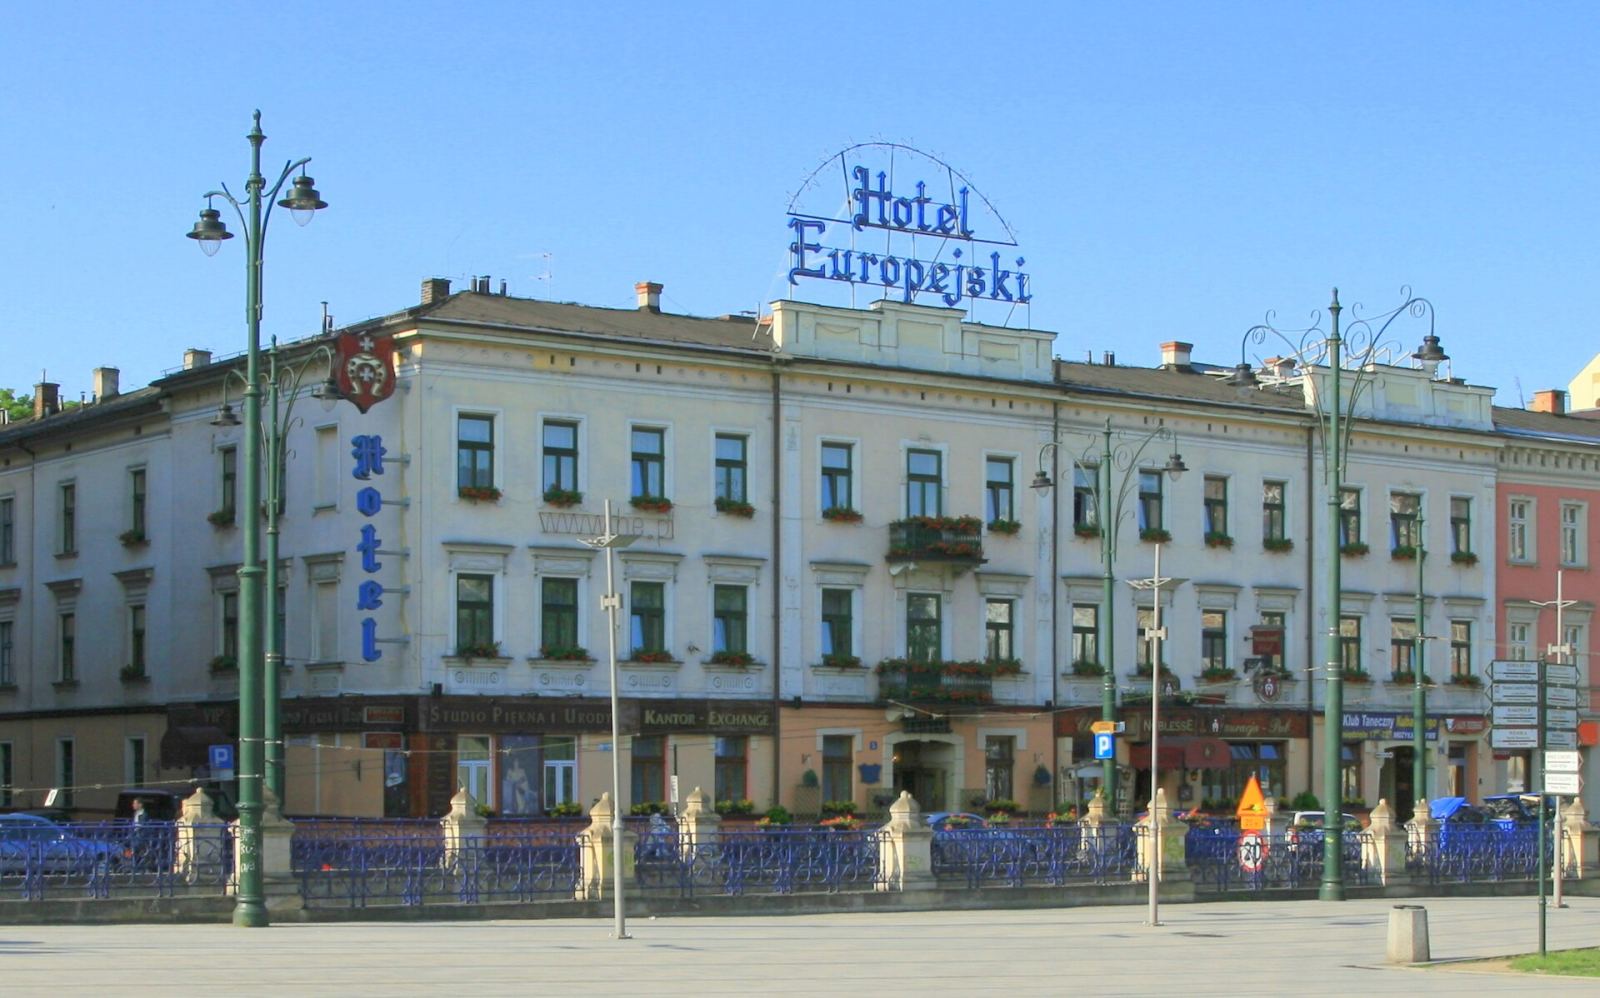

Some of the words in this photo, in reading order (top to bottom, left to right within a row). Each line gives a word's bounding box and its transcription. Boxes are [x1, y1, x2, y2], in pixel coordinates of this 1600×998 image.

[852, 165, 975, 241] Hotel
[787, 217, 1033, 307] Europejski
[351, 434, 387, 662] Hotel
[1143, 718, 1193, 733] NBLESSE
[1342, 713, 1360, 727] Klub
[1361, 713, 1395, 730] Taneczny
[1099, 736, 1109, 756] P
[215, 749, 227, 766] P
